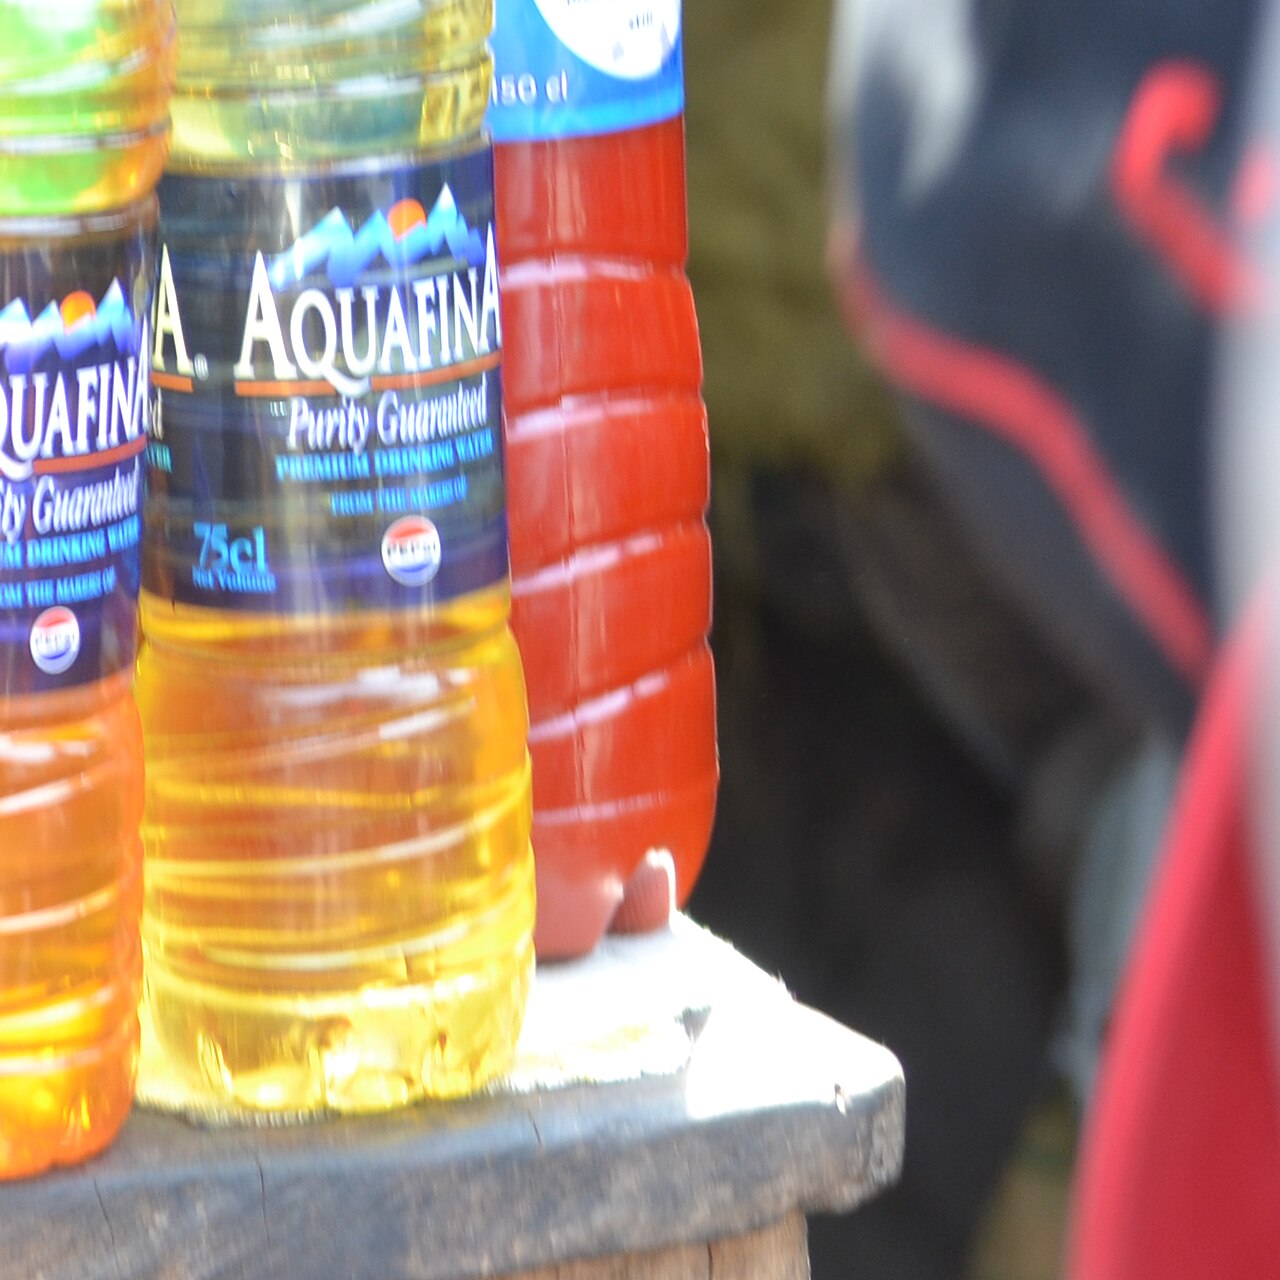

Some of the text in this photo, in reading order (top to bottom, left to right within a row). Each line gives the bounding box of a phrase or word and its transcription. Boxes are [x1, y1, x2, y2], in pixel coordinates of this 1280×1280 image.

[233, 222, 501, 397] AQUAFINA
[286, 371, 488, 457] Purity Guaranteed
[26, 528, 106, 568] DRINKING
[192, 521, 267, 571] 75cl
